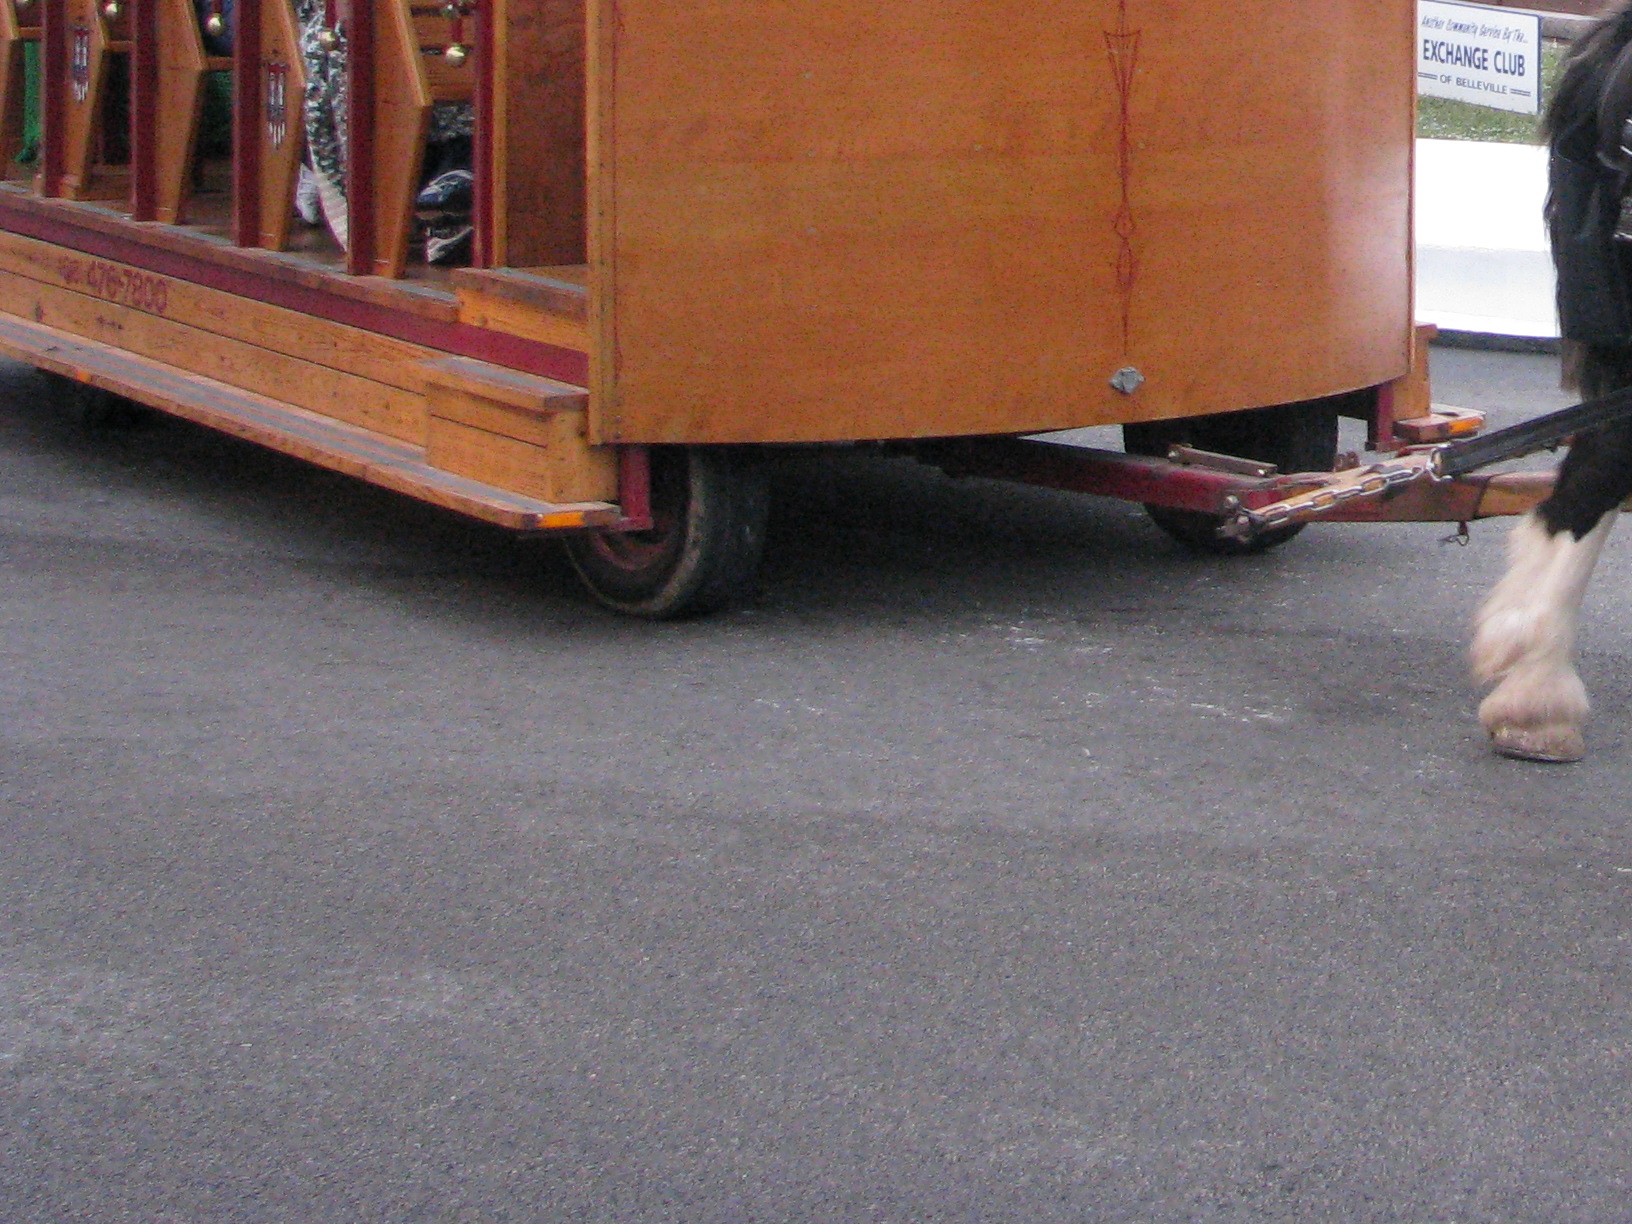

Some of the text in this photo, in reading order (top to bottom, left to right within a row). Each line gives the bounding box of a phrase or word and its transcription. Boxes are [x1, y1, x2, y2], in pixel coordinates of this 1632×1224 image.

[1423, 39, 1525, 77] EXCHANGE CLUB
[1439, 74, 1508, 95] OF BELLEVILLE
